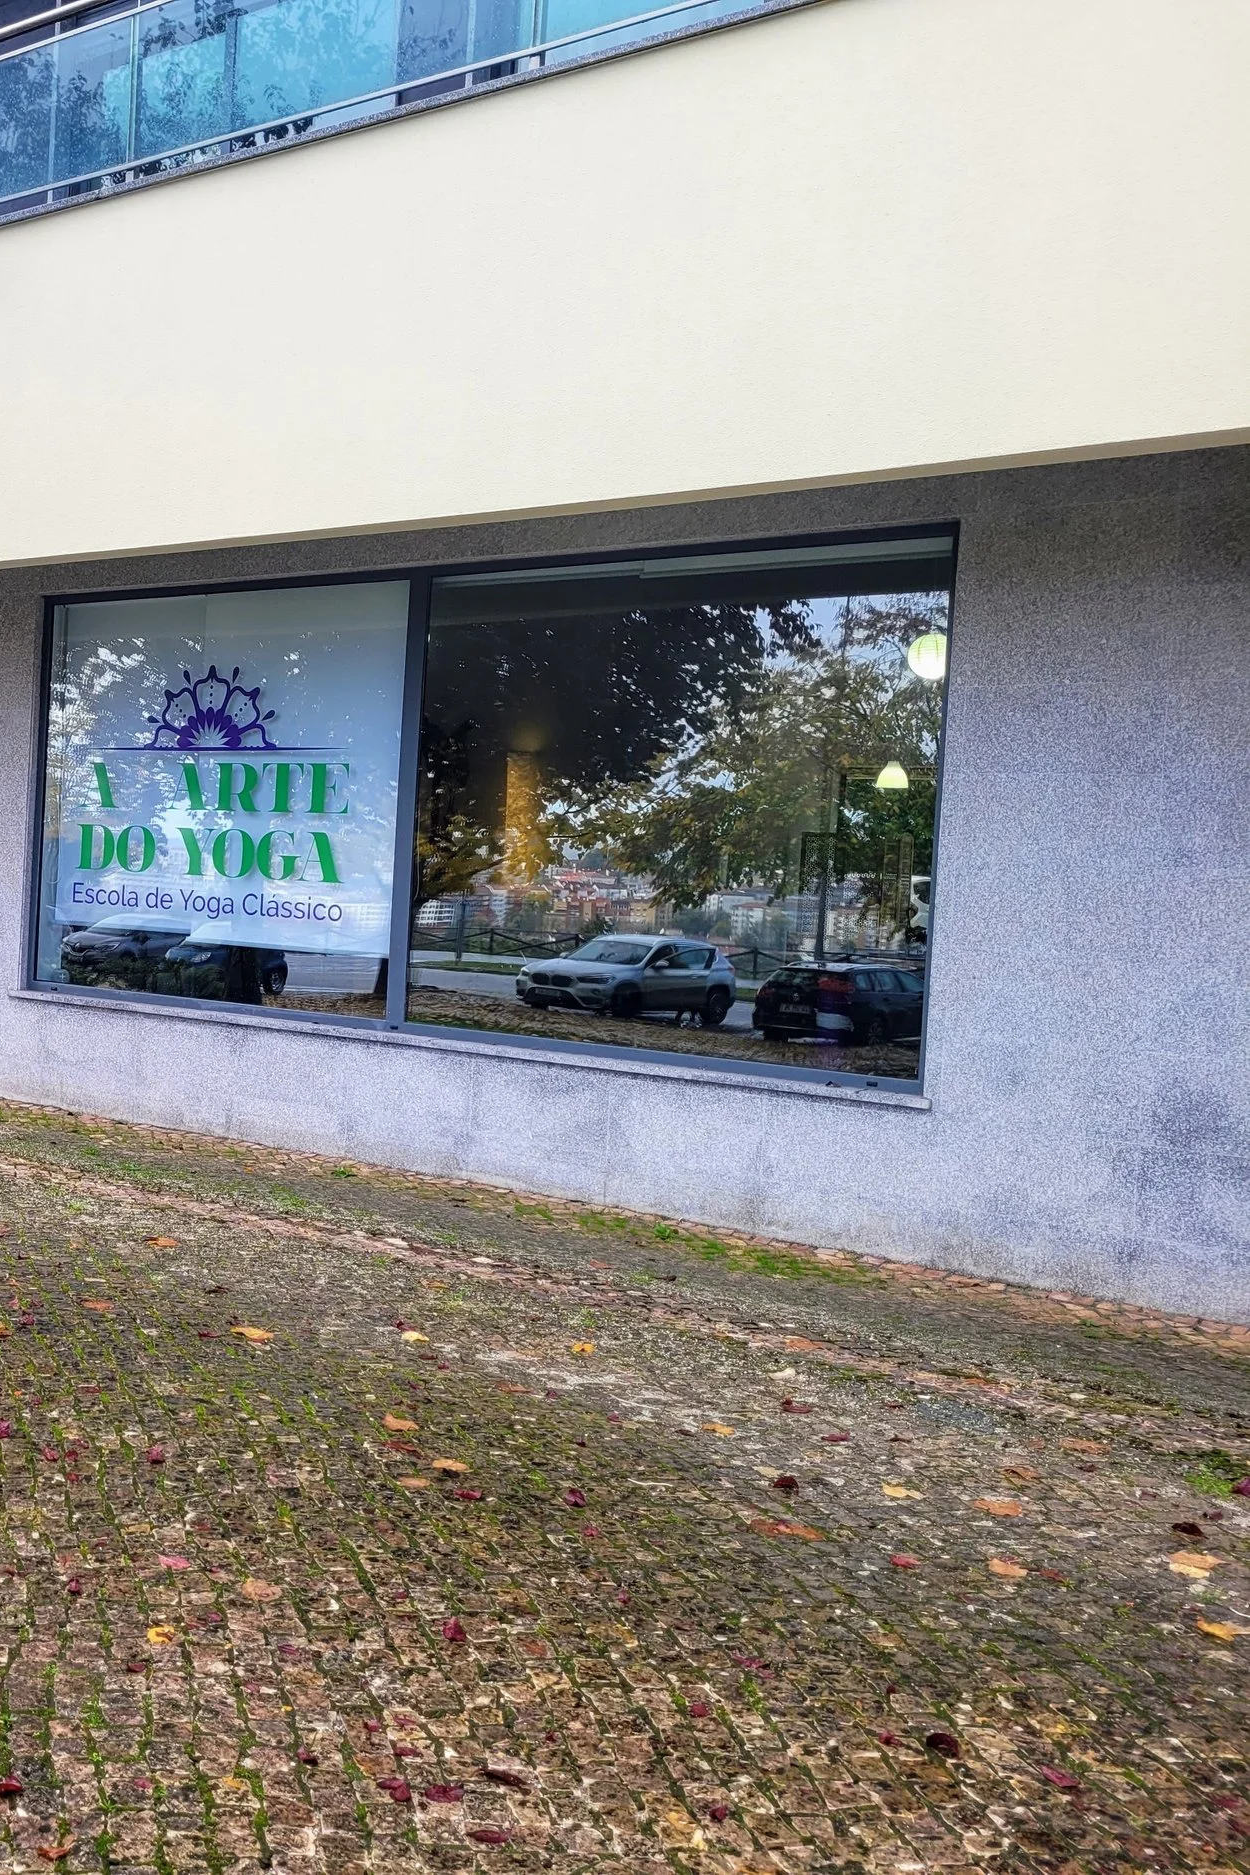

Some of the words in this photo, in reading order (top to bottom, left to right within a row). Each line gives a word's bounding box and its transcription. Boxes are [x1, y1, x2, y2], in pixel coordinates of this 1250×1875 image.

[80, 762, 119, 809] A
[168, 762, 350, 815] ARTE
[75, 823, 156, 873] DO
[177, 827, 344, 884] YOGA
[72, 882, 139, 908] Escola
[145, 887, 173, 909] de
[179, 889, 235, 920] Yoga
[242, 893, 343, 922] Clássico
